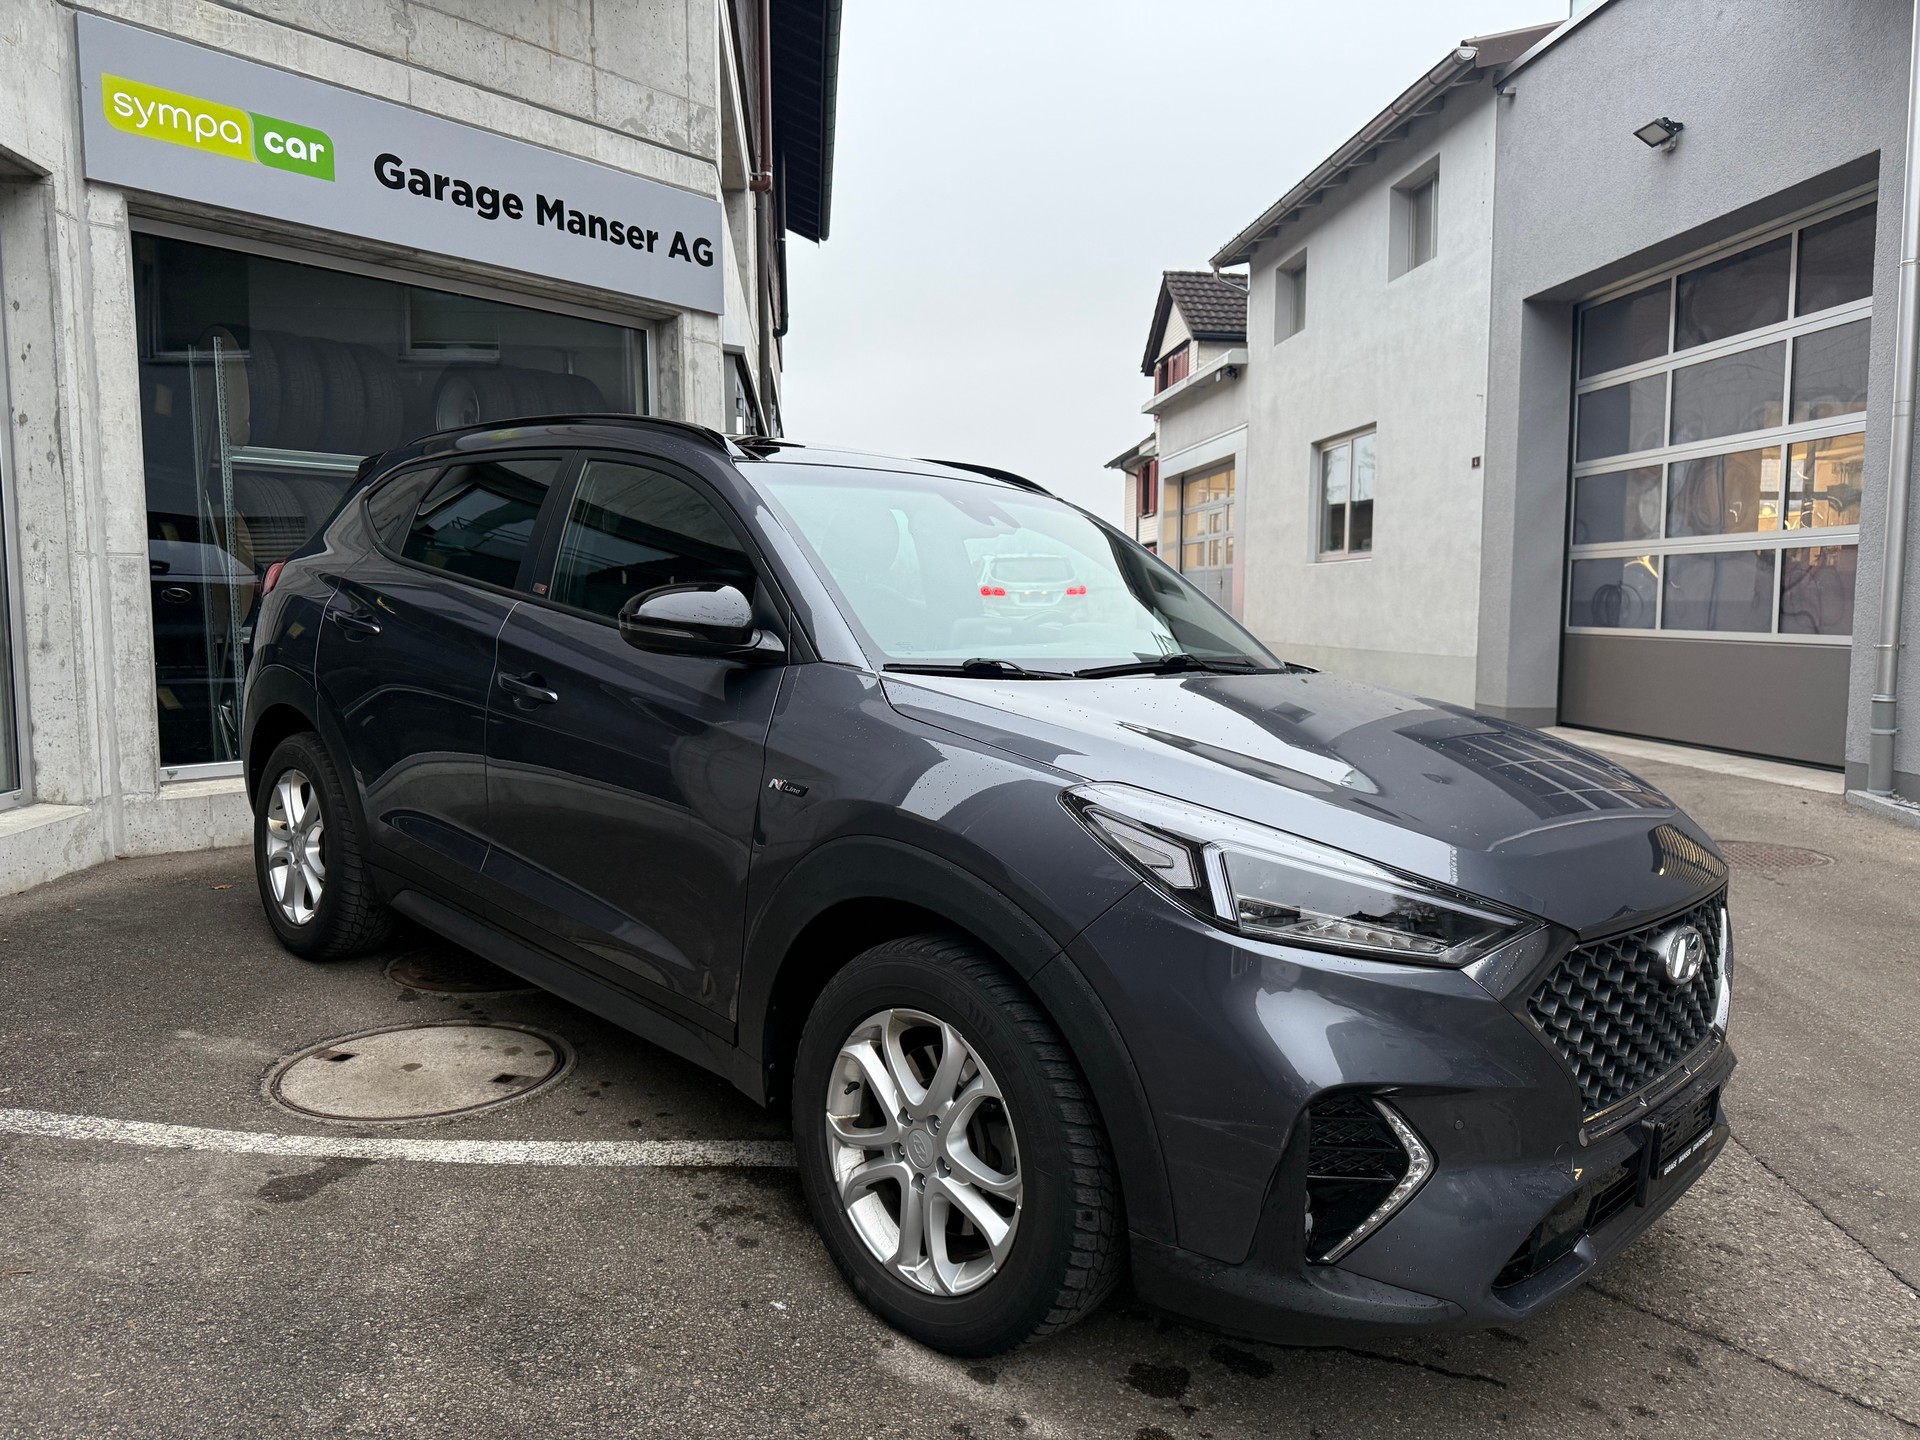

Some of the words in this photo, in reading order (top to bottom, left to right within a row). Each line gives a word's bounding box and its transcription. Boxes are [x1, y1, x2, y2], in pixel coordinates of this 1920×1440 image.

[113, 92, 242, 145] sympa
[263, 131, 325, 163] car
[373, 152, 524, 221] Garage
[536, 193, 659, 255] Manser
[668, 230, 714, 268] AG
[785, 786, 801, 794] Line
